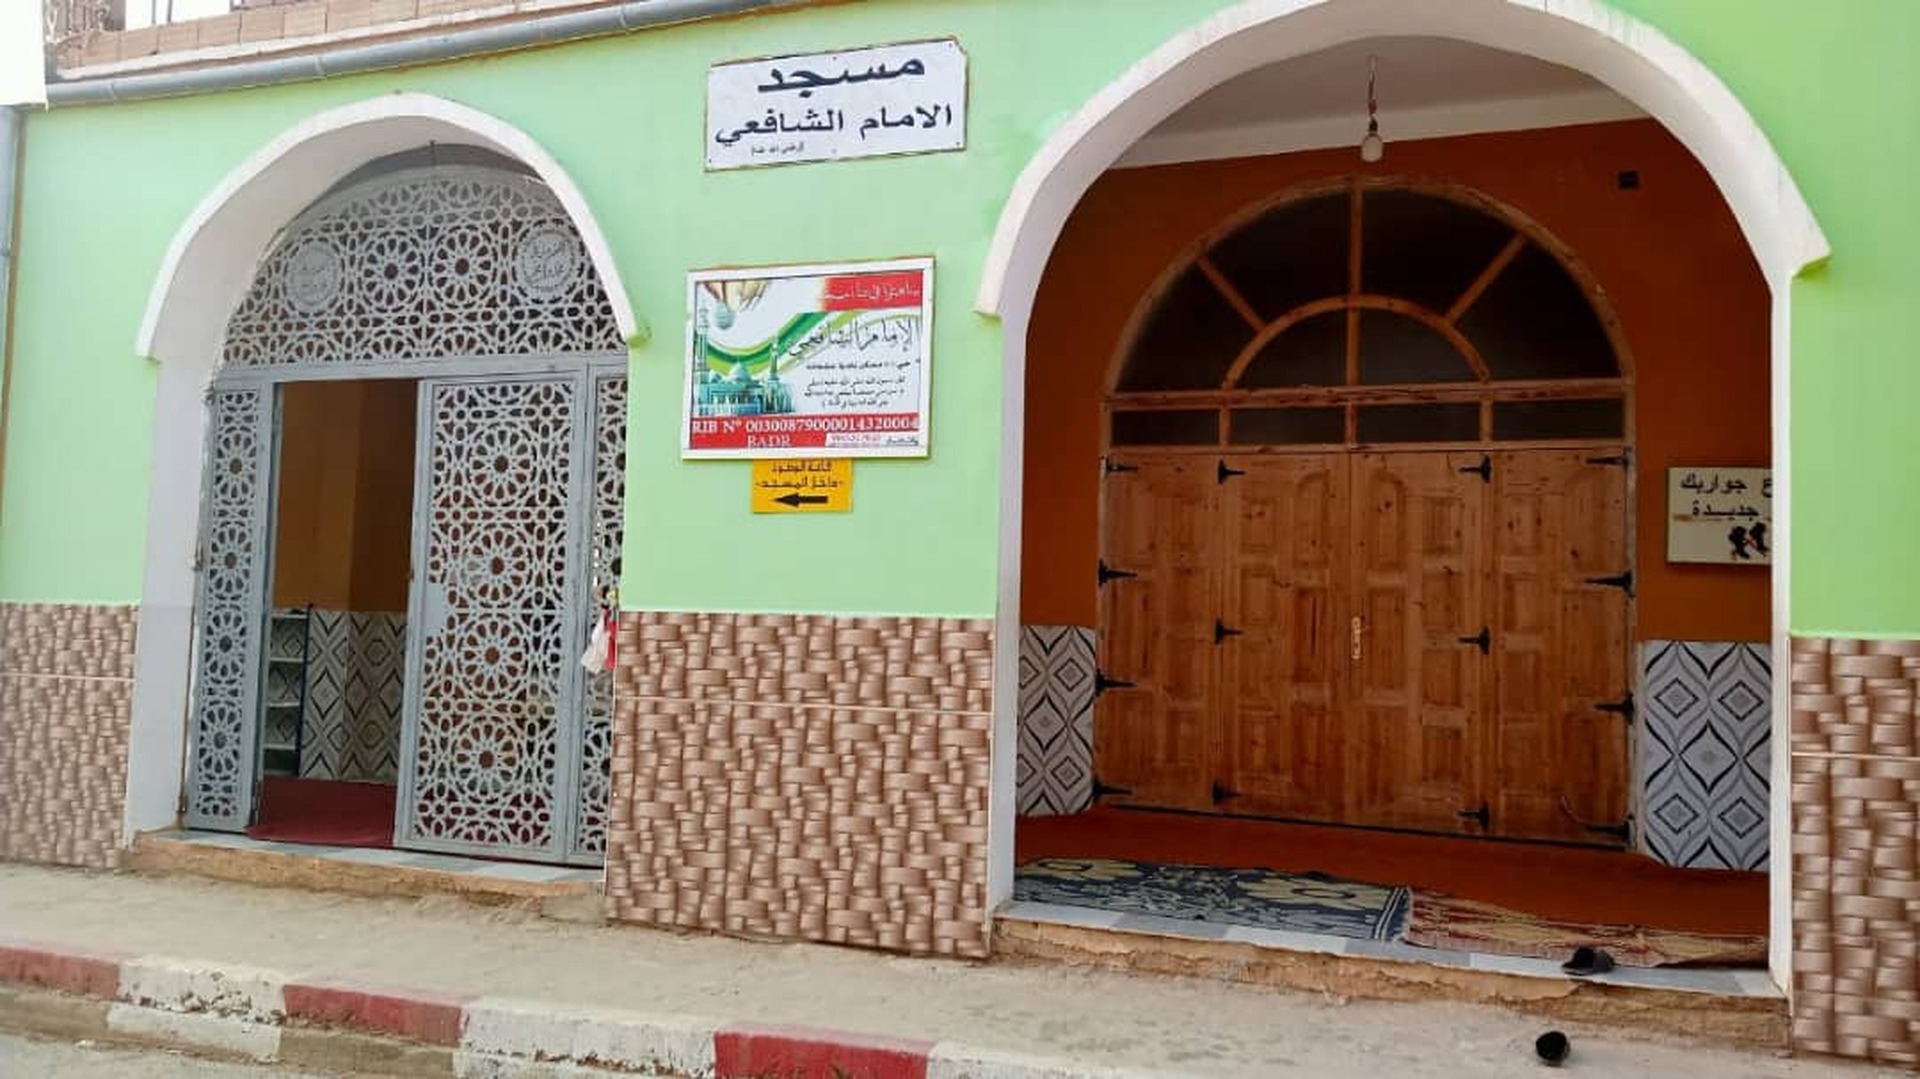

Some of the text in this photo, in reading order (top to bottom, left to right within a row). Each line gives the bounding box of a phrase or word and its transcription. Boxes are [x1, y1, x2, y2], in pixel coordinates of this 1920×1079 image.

[758, 58, 924, 98] مسجد
[715, 103, 951, 147] الامام الشافعي
[692, 420, 718, 434] RIB
